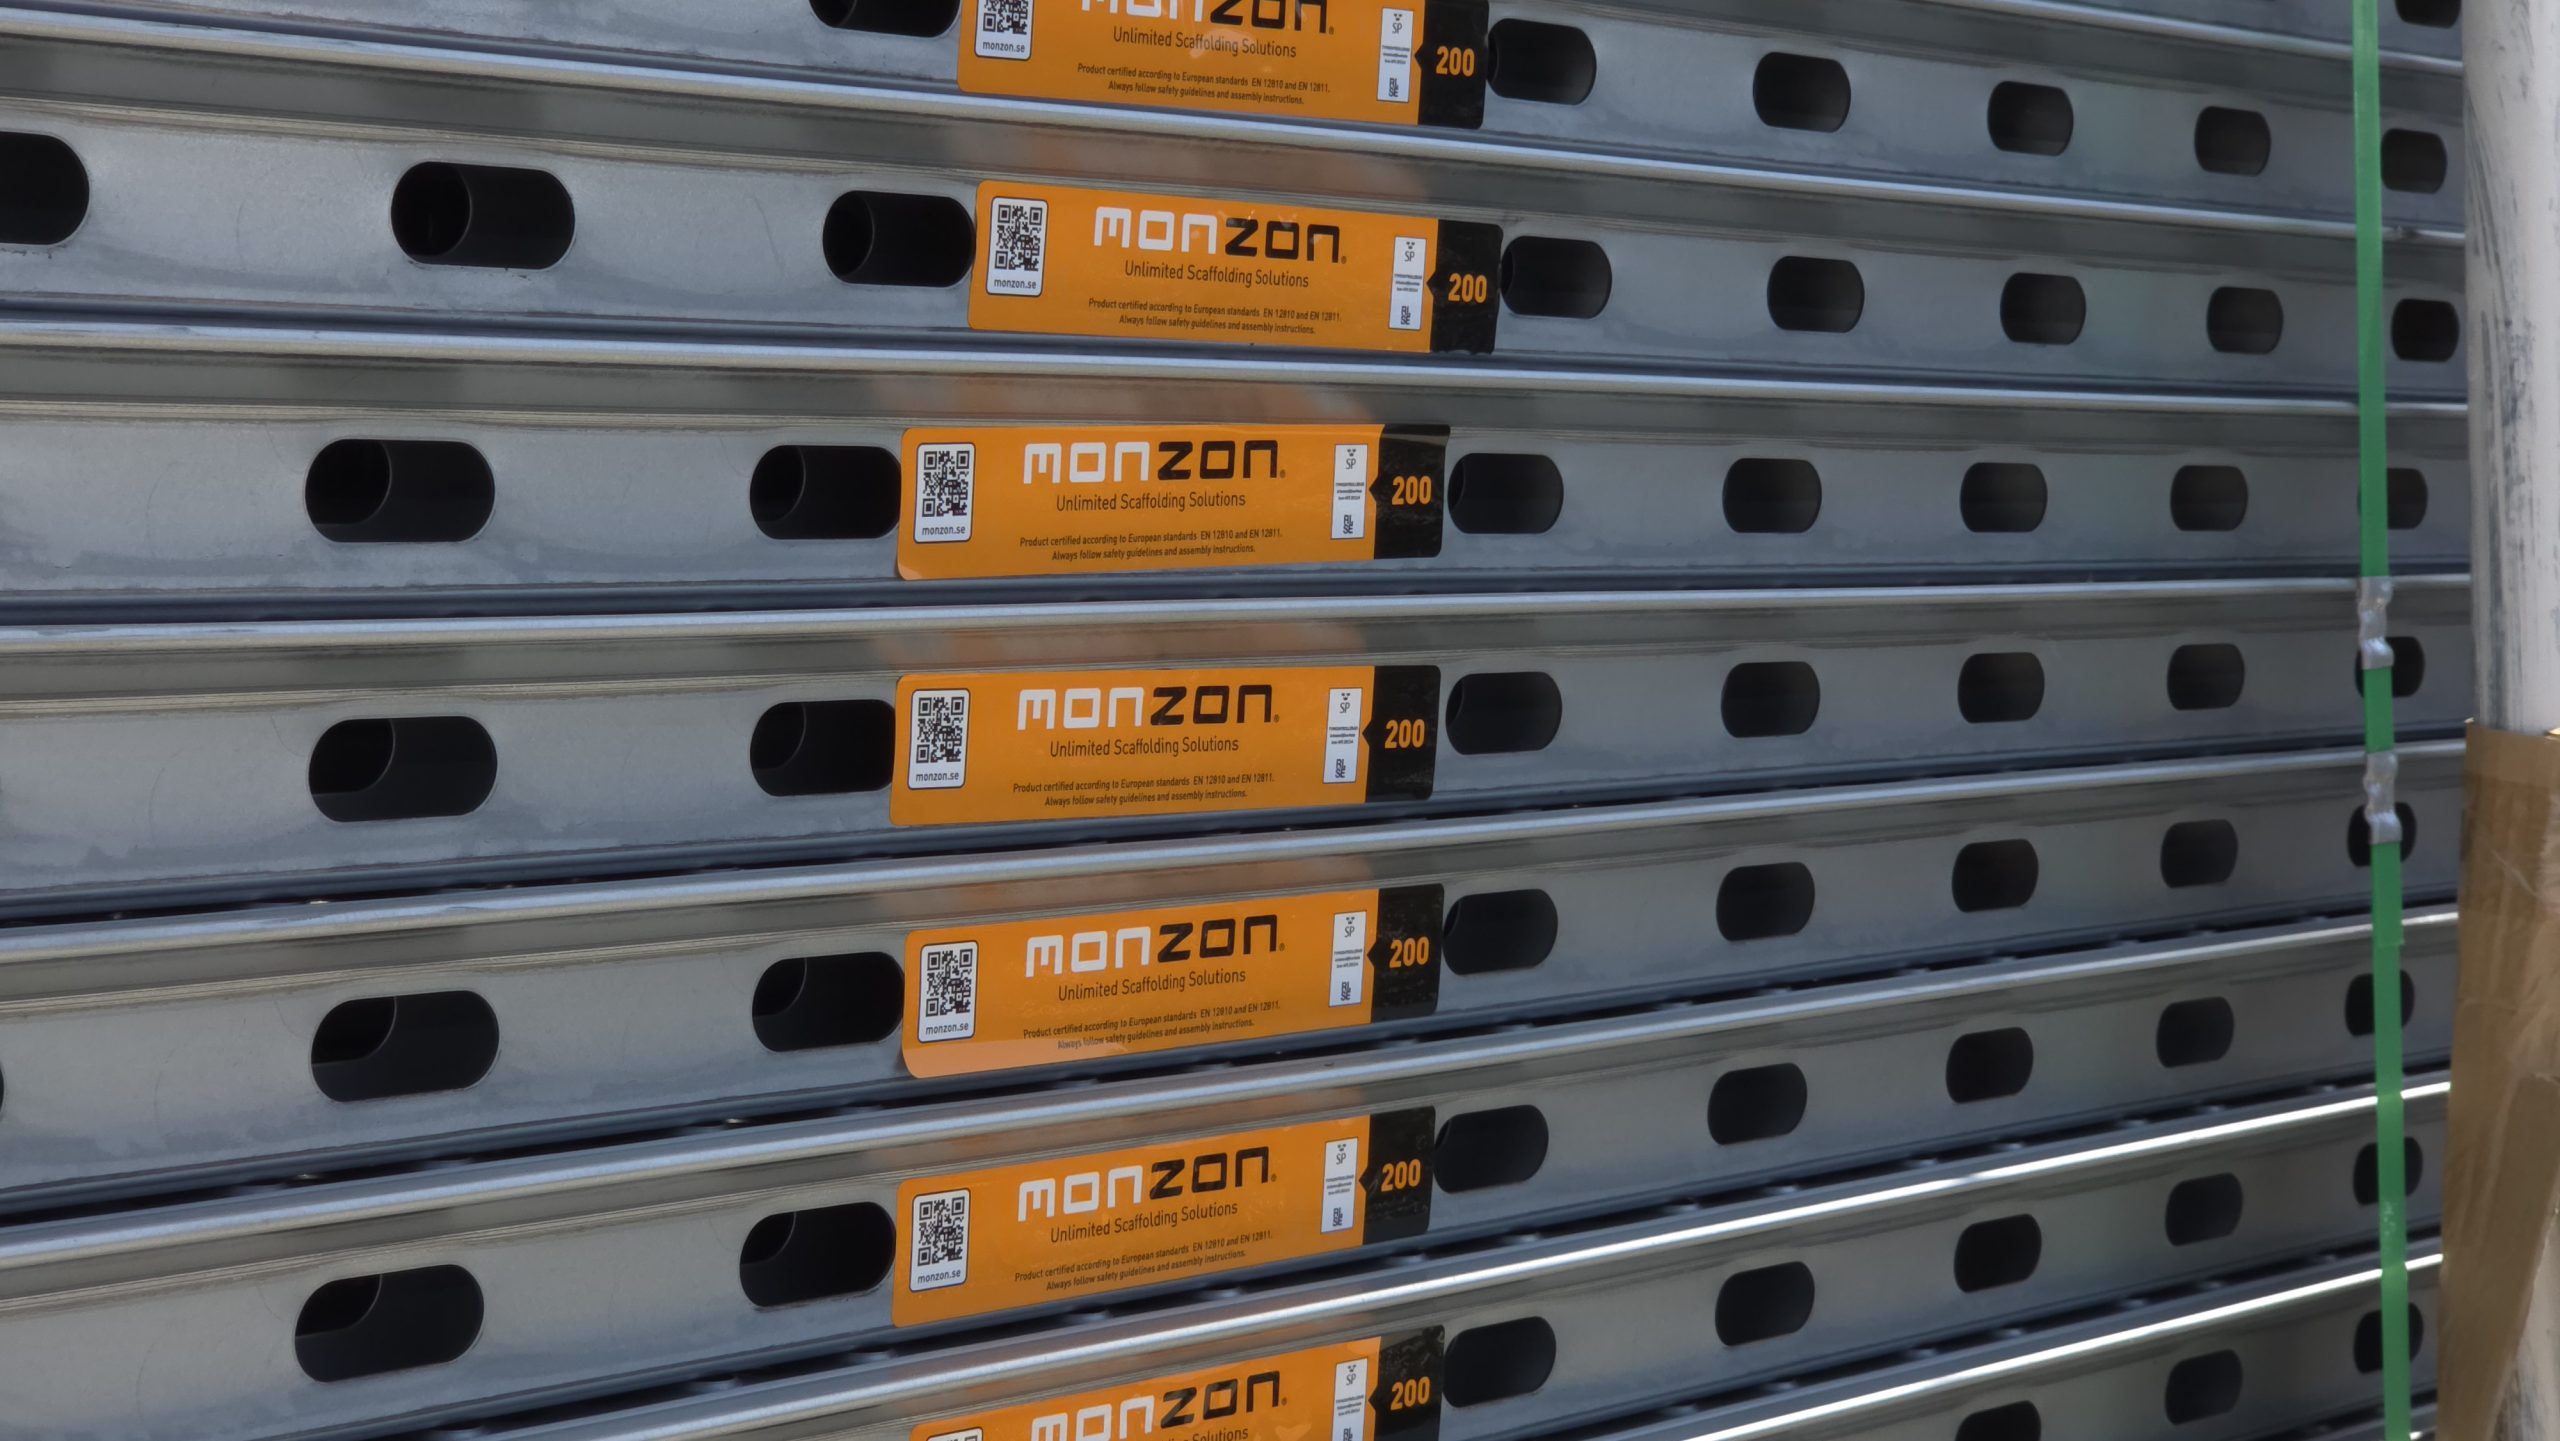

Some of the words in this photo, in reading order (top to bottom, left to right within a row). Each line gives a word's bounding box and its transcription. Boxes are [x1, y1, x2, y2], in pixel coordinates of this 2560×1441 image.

[982, 40, 1026, 53] monzon.se
[1112, 25, 1172, 47] Unlimited
[1174, 31, 1239, 57] Scaffolding
[1240, 36, 1297, 57] Solutions
[1434, 44, 1475, 77] 200
[1077, 62, 1106, 74] Product
[1106, 64, 1136, 76] certified
[1137, 67, 1172, 81] according
[1173, 71, 1180, 80] to
[1181, 71, 1214, 84] European
[1215, 74, 1248, 86] standards
[1251, 77, 1261, 87] EN
[1263, 78, 1283, 88] 12810
[1283, 80, 1297, 90] and
[1297, 81, 1308, 91] EN
[1309, 82, 1330, 92] 12811.
[1107, 79, 1134, 92] Always
[1135, 81, 1156, 92] follow
[1157, 83, 1179, 96] safety
[1180, 85, 1215, 97] guidelines
[1216, 88, 1229, 98] and
[1230, 89, 1262, 103] assembly
[1262, 92, 1305, 104] instructions.
[993, 278, 1037, 289] monzon.se
[1124, 259, 1184, 279] Unlimited
[1186, 264, 1251, 288] Scaffolding
[1252, 268, 1309, 287] Solutions
[1447, 271, 1488, 303] 200
[1088, 297, 1117, 308] Product
[1117, 298, 1147, 310] certified
[1149, 301, 1183, 314] according
[1184, 303, 1192, 312] to
[1192, 303, 1226, 316] European
[1226, 305, 1260, 316] standards
[1262, 308, 1273, 317] EN
[1275, 308, 1295, 318] 12810
[1295, 310, 1309, 319] and
[1309, 310, 1320, 320] EN
[1321, 311, 1342, 321] 12811.
[1118, 313, 1145, 326] Always
[1145, 315, 1167, 325] follow
[1168, 316, 1190, 328] safety
[1191, 317, 1227, 329] guidelines
[1227, 319, 1241, 329] and
[1241, 320, 1273, 333] assembly
[1274, 322, 1316, 333] instructions.
[1055, 494, 1117, 511] Unlimited
[1119, 492, 1186, 512] Scaffolding
[1188, 490, 1247, 507] Solutions
[1391, 474, 1432, 505] 200
[921, 525, 966, 536] monzon.se
[1019, 536, 1049, 546] Product
[1050, 534, 1080, 545] certified
[1082, 533, 1117, 545] according
[1118, 533, 1126, 543] to
[1127, 531, 1161, 544] European
[1162, 530, 1197, 541] standards
[1199, 530, 1211, 540] EN
[1212, 529, 1233, 539] 12810
[1234, 529, 1247, 538] and
[1248, 528, 1259, 538] EN
[1260, 527, 1282, 537] 12811.
[1051, 549, 1078, 561] Always
[1079, 548, 1102, 558] follow
[1102, 547, 1125, 559] safety
[1126, 546, 1163, 558] guidelines
[1164, 545, 1178, 555] and
[1179, 544, 1211, 556] assembly
[1212, 542, 1256, 553] instructions.
[1049, 739, 1111, 757] Unlimited
[1112, 737, 1180, 757] Scaffolding
[1181, 735, 1240, 752] Solutions
[1383, 718, 1426, 749] 200
[915, 771, 960, 782] monzon.se
[1012, 781, 1042, 792] Product
[1043, 780, 1073, 791] certified
[1075, 779, 1110, 790] according
[1111, 779, 1119, 788] to
[1120, 777, 1154, 789] European
[1155, 776, 1190, 786] standards
[1192, 775, 1203, 785] EN
[1205, 774, 1226, 784] 12810
[1226, 774, 1240, 783] and
[1241, 773, 1252, 783] EN
[1253, 772, 1275, 782] 12811.
[1044, 795, 1071, 807] Always
[1072, 794, 1094, 804] follow
[1095, 793, 1117, 804] safety
[1119, 791, 1155, 804] guidelines
[1156, 790, 1170, 800] and
[1171, 789, 1204, 801] assembly
[1204, 787, 1248, 798] instructions.
[1388, 935, 1429, 969] 200
[1057, 979, 1118, 1001] Unlimited
[1120, 972, 1186, 995] Scaffolding
[1188, 966, 1246, 987] Solutions
[925, 1022, 969, 1035] monzon.se
[1022, 1026, 1051, 1038] Product
[1052, 1022, 1082, 1035] certified
[1084, 1018, 1118, 1031] according
[1119, 1017, 1127, 1027] to
[1128, 1013, 1162, 1026] European
[1163, 1009, 1197, 1022] standards
[1199, 1007, 1210, 1018] EN
[1212, 1005, 1232, 1016] 12810
[1233, 1003, 1247, 1014] and
[1247, 1002, 1259, 1012] EN
[1259, 999, 1281, 1011] 12811.
[1104, 1031, 1126, 1043] safety
[1127, 1026, 1163, 1042] guidelines
[1164, 1025, 1178, 1036] and
[1179, 1021, 1211, 1034] assembly
[1212, 1016, 1255, 1030] instructions.
[1380, 1158, 1421, 1193] 200
[1049, 1218, 1110, 1243] Unlimited
[1112, 1207, 1178, 1233] Scaffolding
[1180, 1198, 1238, 1222] Solutions
[1014, 1268, 1043, 1281] Product
[1044, 1262, 1074, 1276] certified
[1076, 1256, 1110, 1271] according
[1112, 1255, 1119, 1265] to
[1120, 1249, 1154, 1264] European
[1155, 1243, 1189, 1258] standards
[1192, 1241, 1203, 1251] EN
[1204, 1237, 1225, 1249] 12810
[1225, 1235, 1239, 1246] and
[1240, 1233, 1251, 1243] EN
[1252, 1229, 1273, 1241] 12811.
[1045, 1276, 1072, 1290] Always
[1073, 1273, 1095, 1285] follow
[1096, 1269, 1118, 1281] safety
[1119, 1262, 1155, 1279] guidelines
[1157, 1260, 1170, 1271] and
[1171, 1254, 1203, 1269] assembly
[1204, 1247, 1247, 1263] instructions.
[916, 1269, 961, 1284] monzon.se
[1389, 1375, 1431, 1411] 200
